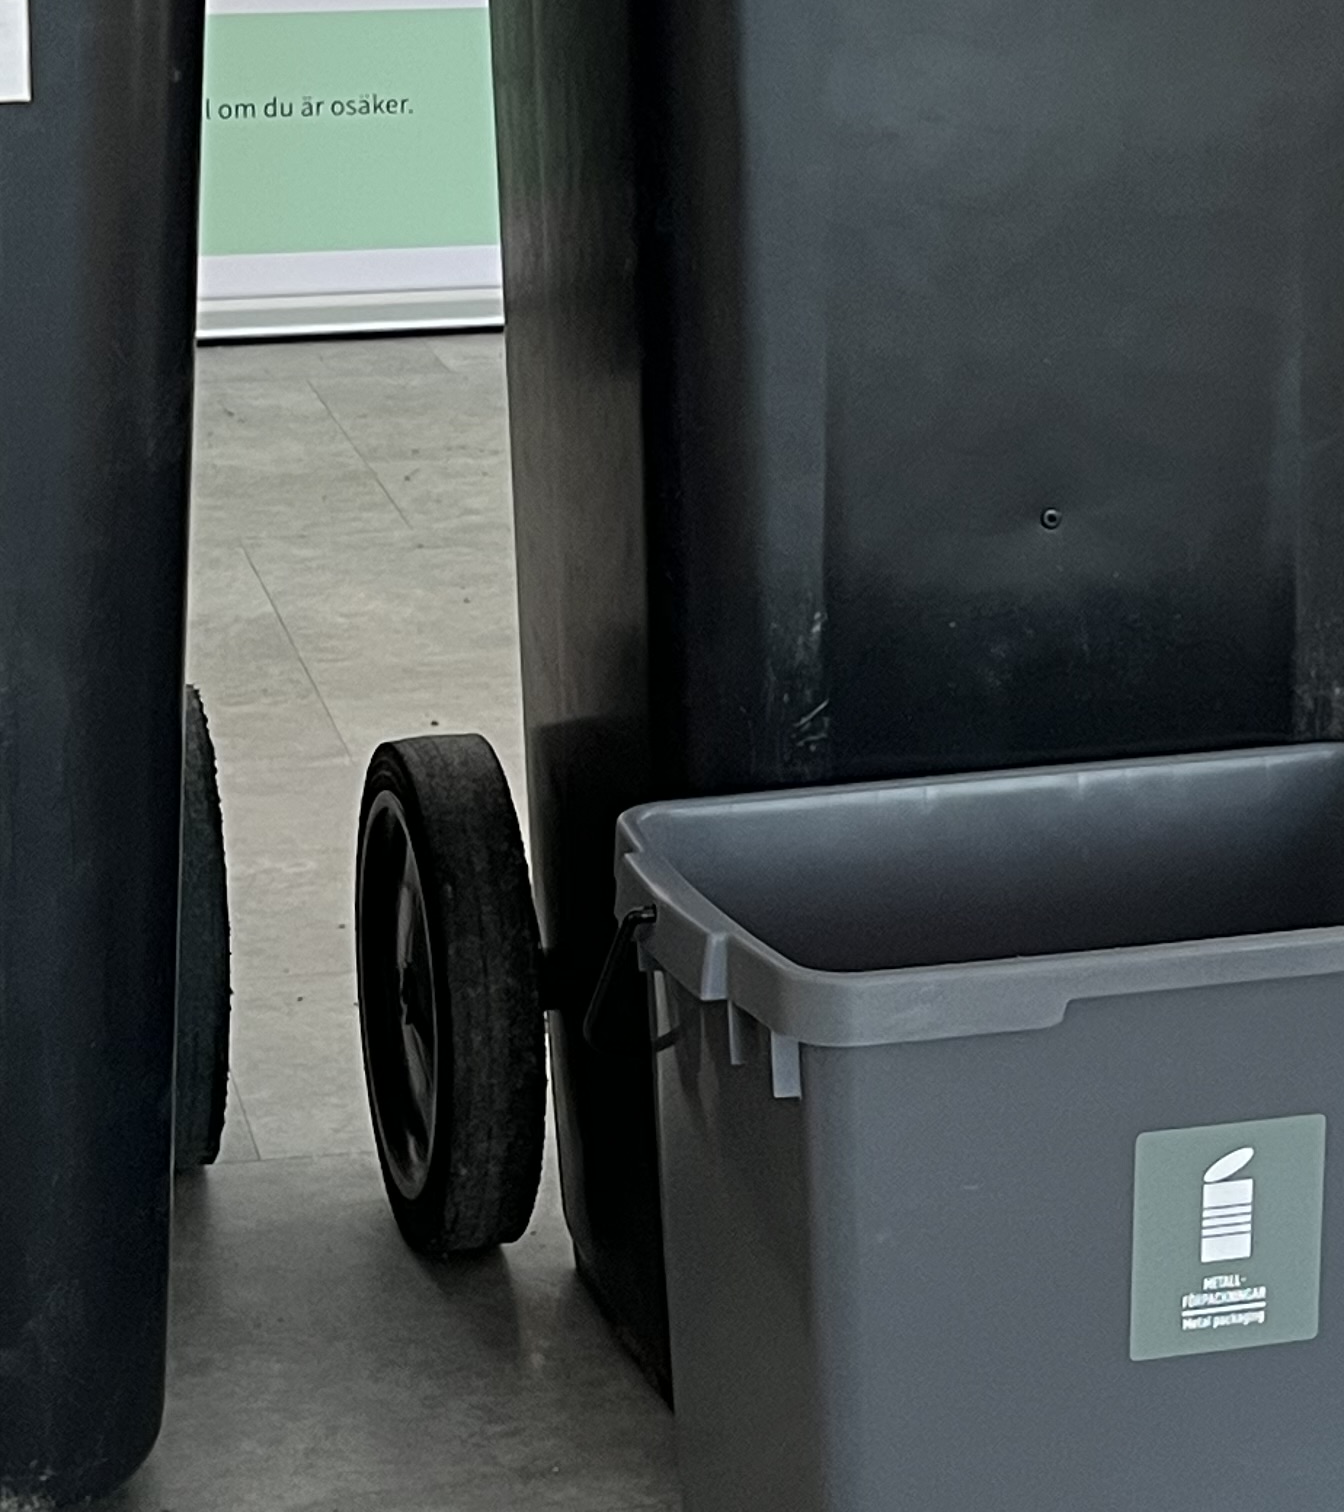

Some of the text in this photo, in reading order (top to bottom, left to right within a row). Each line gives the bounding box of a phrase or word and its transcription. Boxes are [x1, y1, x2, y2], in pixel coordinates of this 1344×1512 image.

[218, 102, 255, 120] om
[263, 96, 293, 118] du
[301, 96, 324, 117] är
[331, 93, 414, 116] osäker.
[1182, 1316, 1211, 1330] Metal
